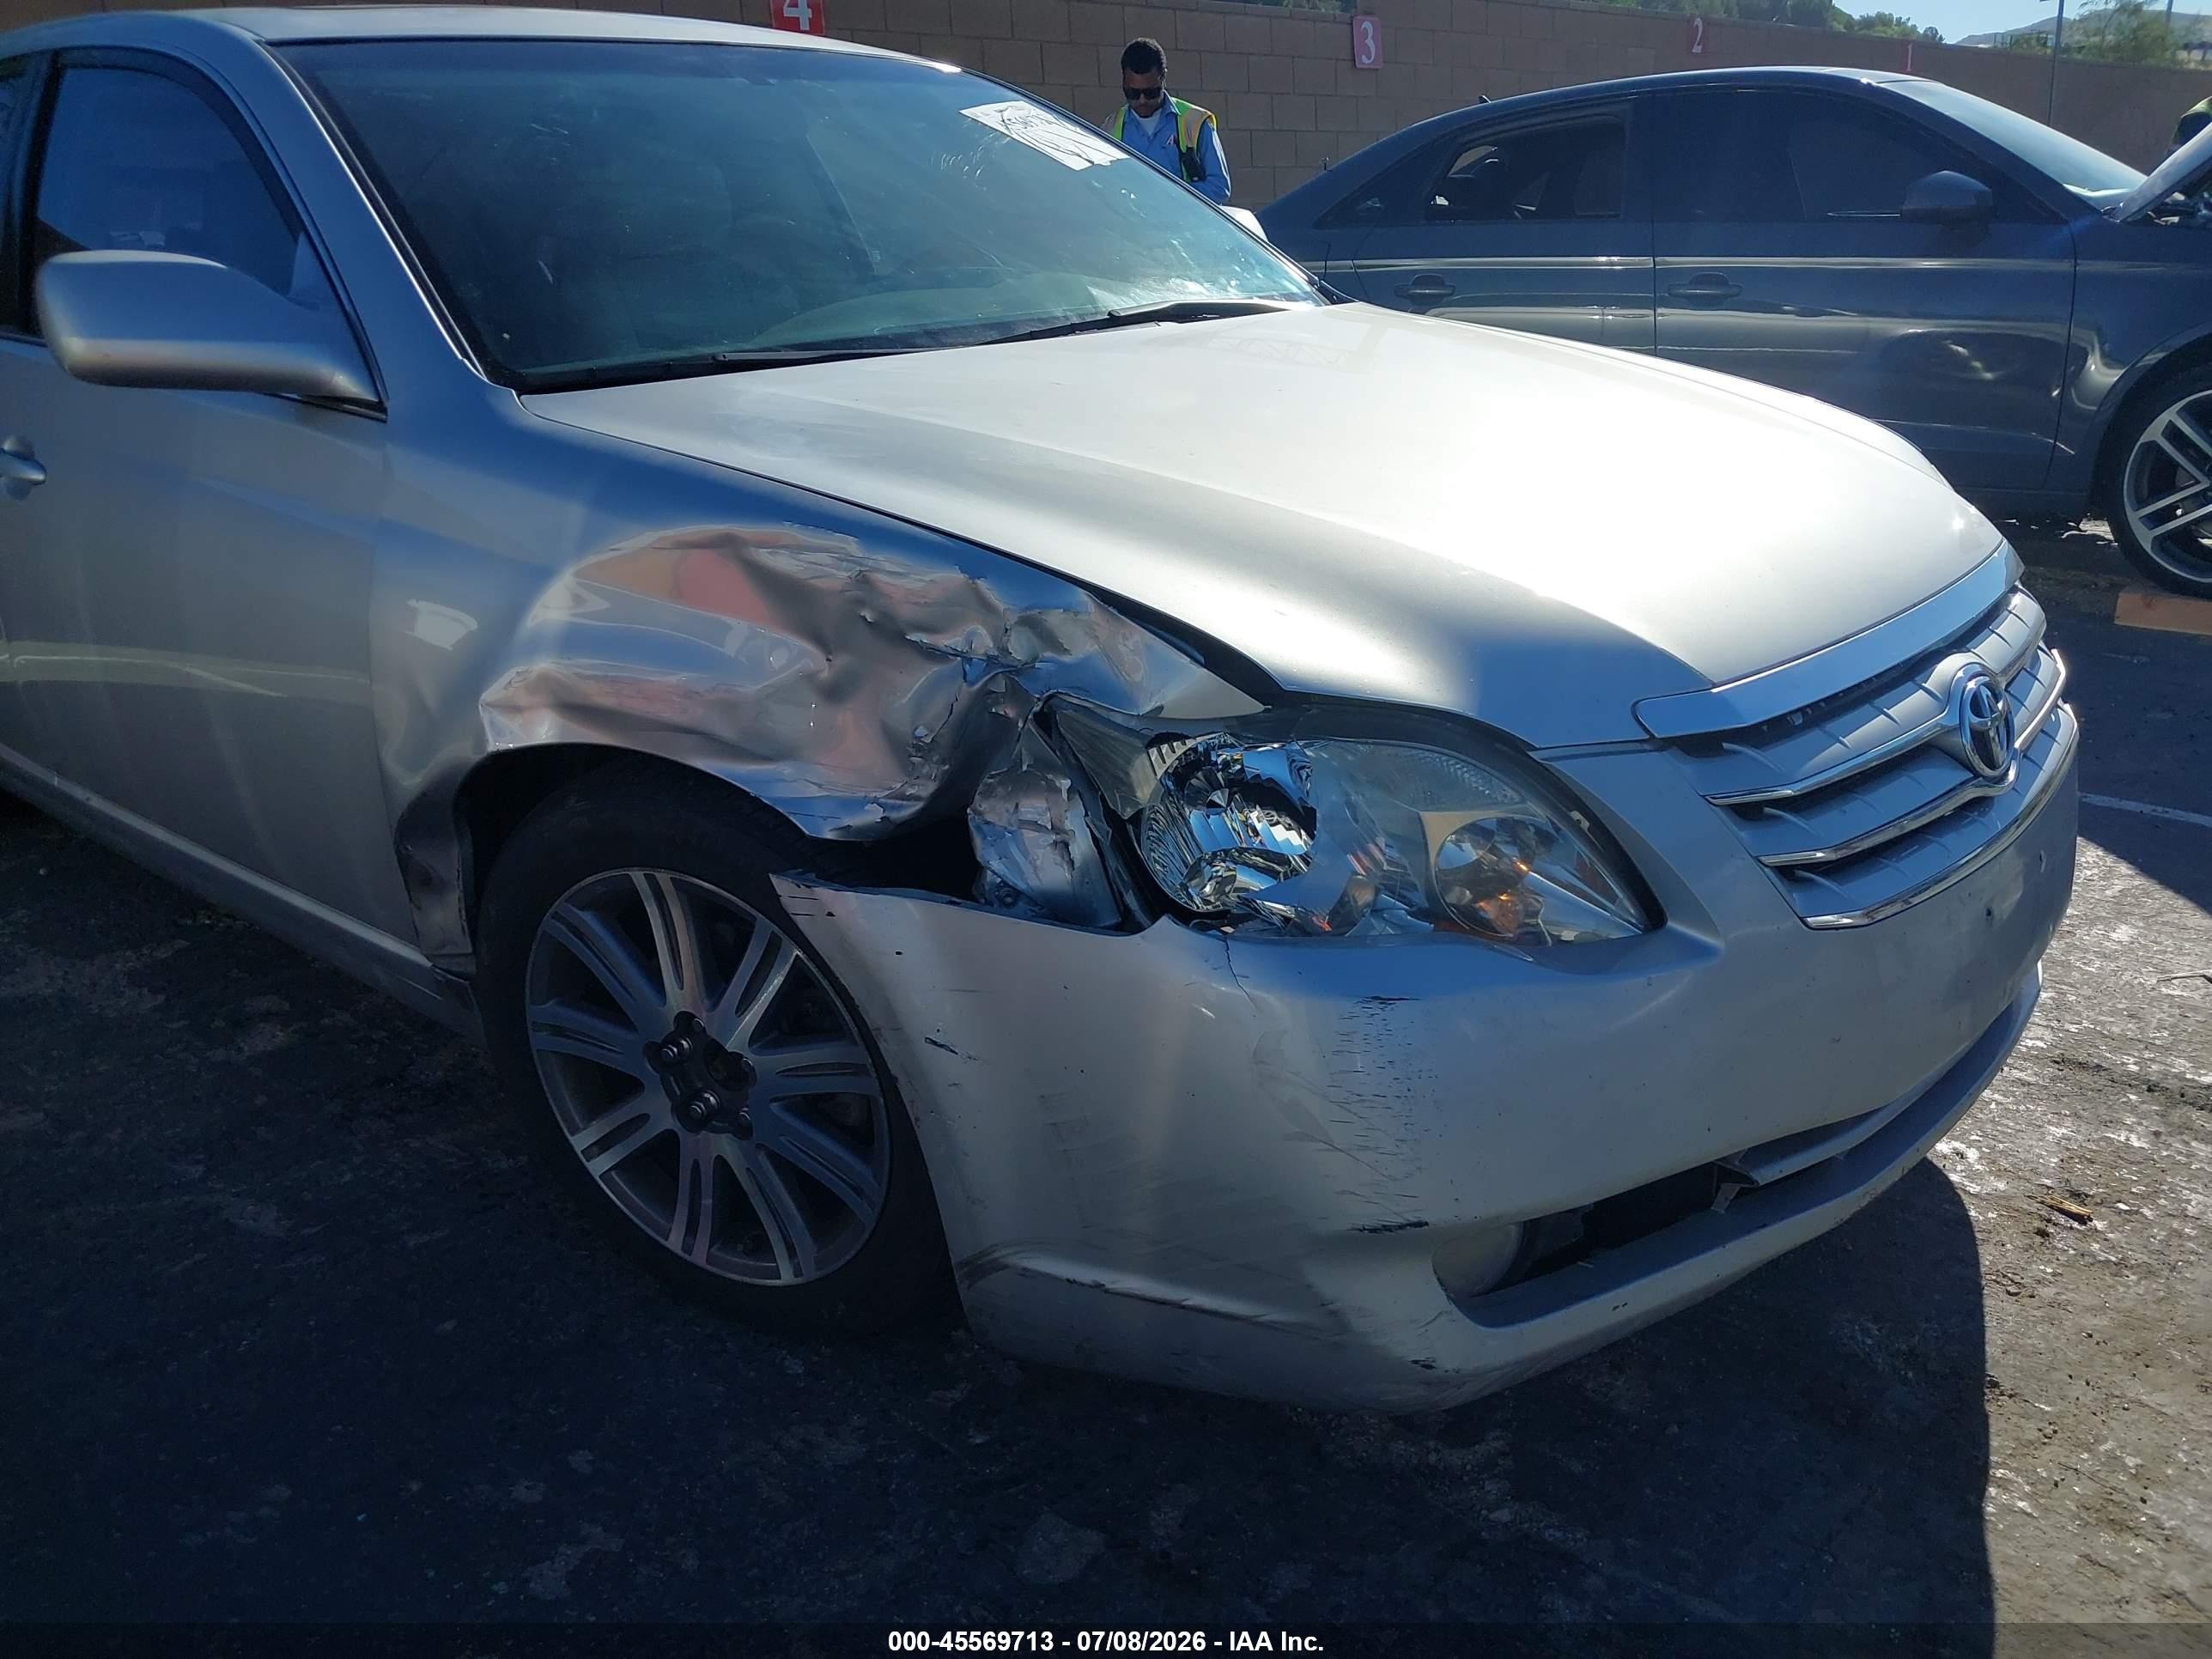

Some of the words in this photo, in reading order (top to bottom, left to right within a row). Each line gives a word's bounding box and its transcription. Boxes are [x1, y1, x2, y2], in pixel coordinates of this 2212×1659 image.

[783, 0, 812, 30] 4
[1360, 20, 1376, 64] 3
[1692, 17, 1703, 53] 2
